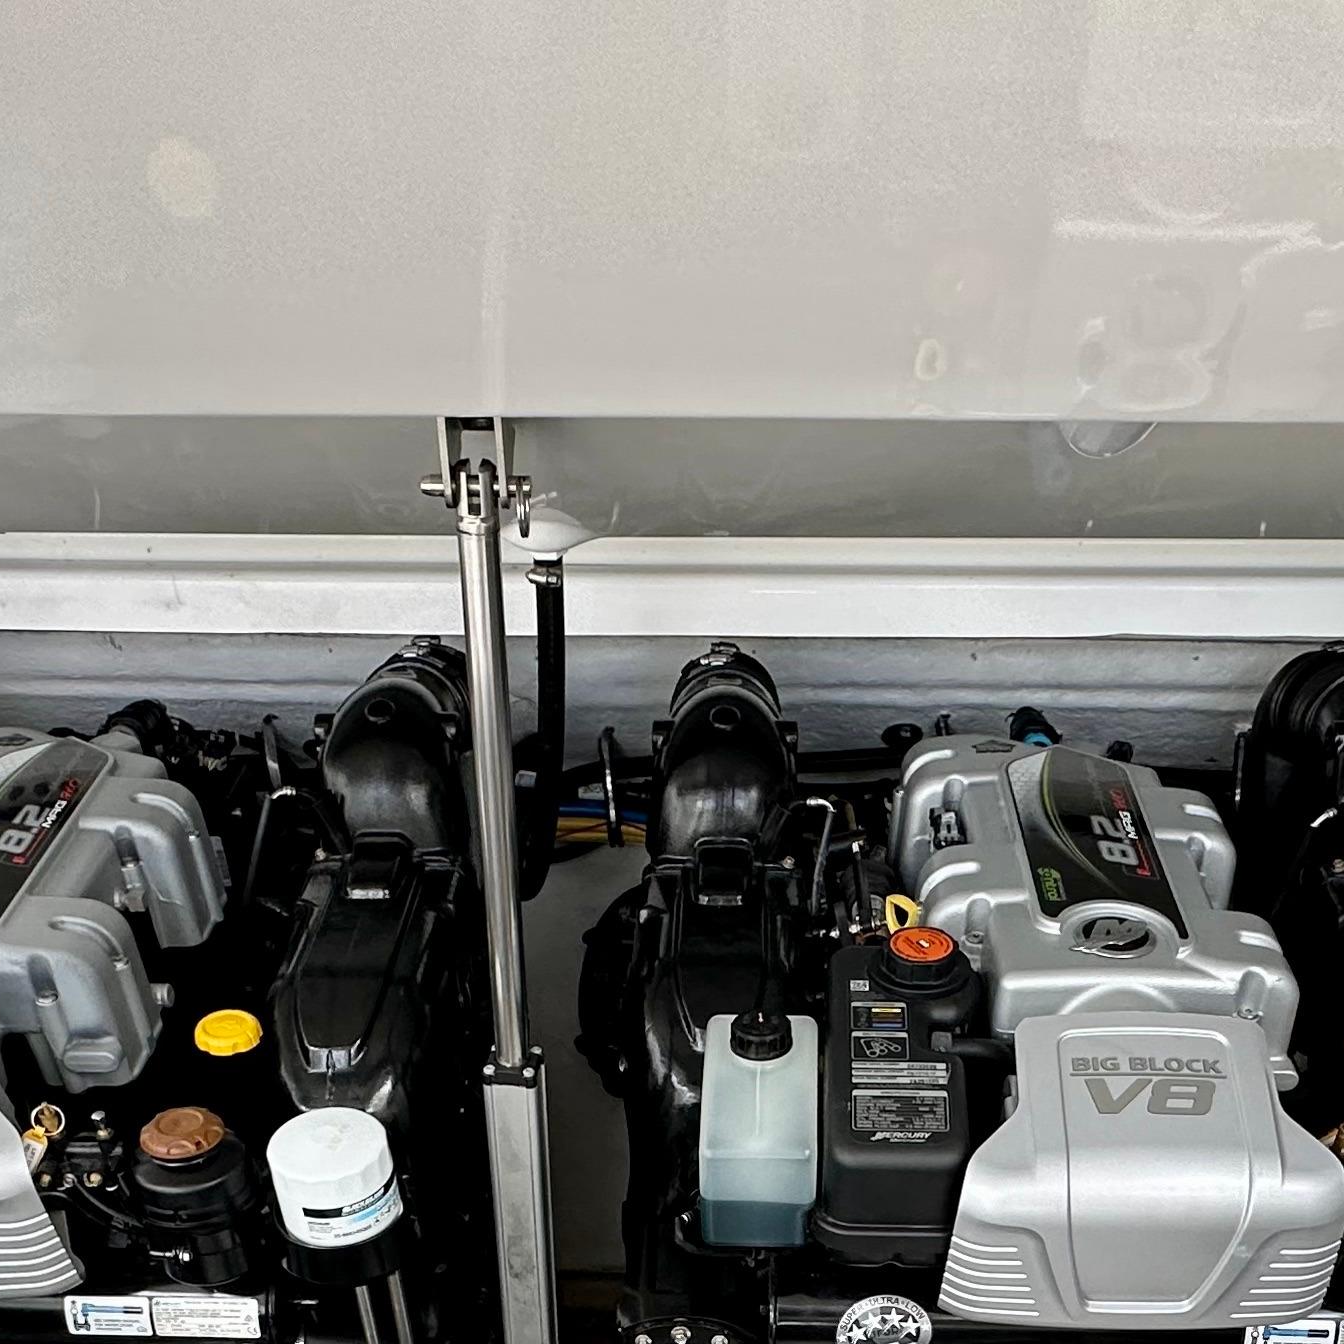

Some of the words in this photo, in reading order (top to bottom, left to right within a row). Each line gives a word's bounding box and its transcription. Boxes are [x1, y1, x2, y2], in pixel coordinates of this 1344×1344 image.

[1089, 814, 1139, 867] 8.2
[1071, 1056, 1121, 1072] BIG
[1128, 1056, 1223, 1074] BLOCK
[1084, 1078, 1216, 1115] V8
[870, 1132, 932, 1141] MERCURY
[869, 1296, 900, 1306] ULTRA
[905, 1301, 926, 1321] LOW
